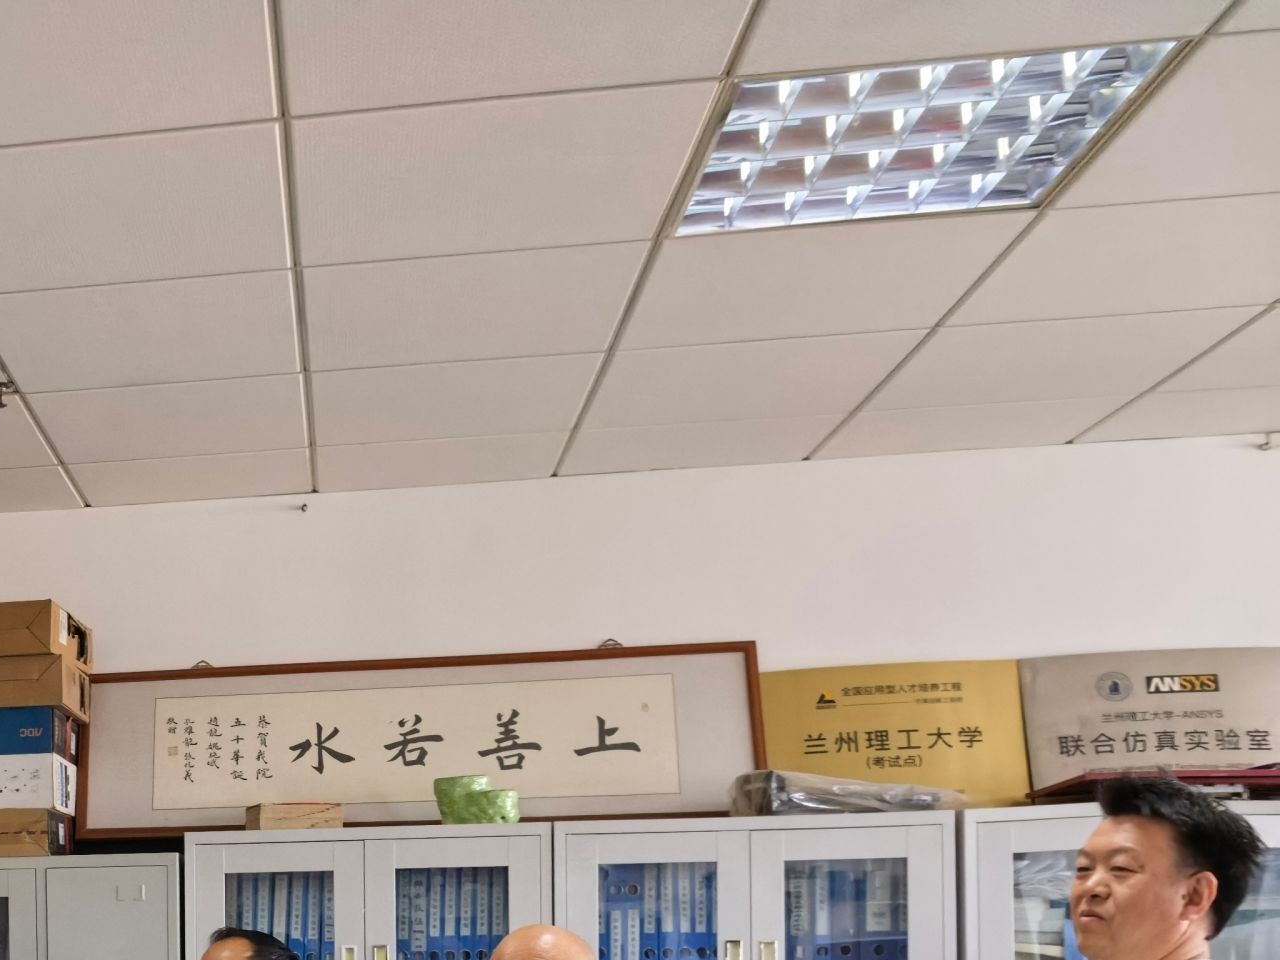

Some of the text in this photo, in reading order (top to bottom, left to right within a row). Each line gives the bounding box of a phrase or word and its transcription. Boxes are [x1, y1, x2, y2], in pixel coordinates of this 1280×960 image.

[1149, 675, 1217, 692] ANSYS
[803, 726, 983, 755] 兰州理工大学
[1057, 728, 1273, 757] 联合仿真实验室
[865, 755, 923, 769] (考试点)
